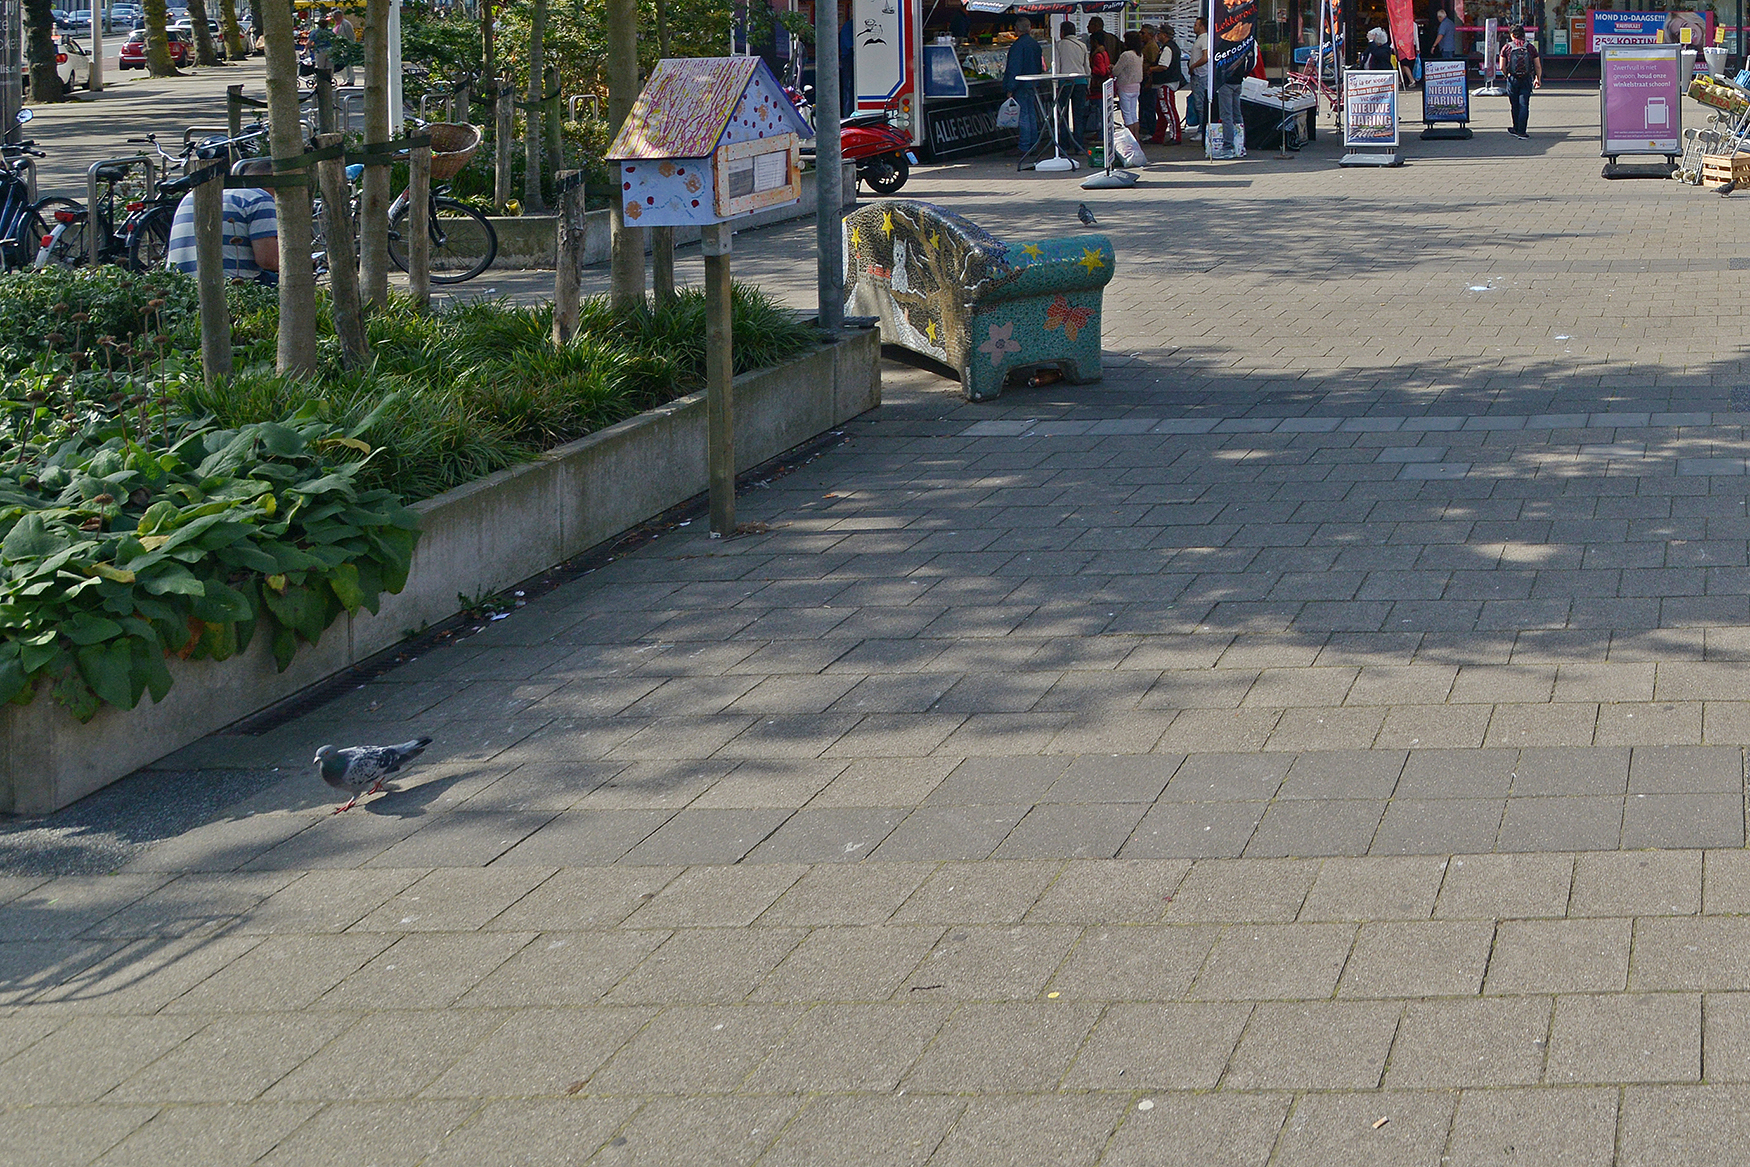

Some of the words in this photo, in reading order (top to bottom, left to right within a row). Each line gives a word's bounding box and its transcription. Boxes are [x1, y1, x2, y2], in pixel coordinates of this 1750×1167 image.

[1018, 3, 1073, 13] Kibbeling
[1620, 14, 1665, 22] 10-DAAGSE!!!
[1429, 86, 1462, 94] NIEUWE
[1428, 96, 1463, 106] HARING
[1352, 103, 1390, 114] NIEUWE
[1350, 115, 1392, 127] HARING
